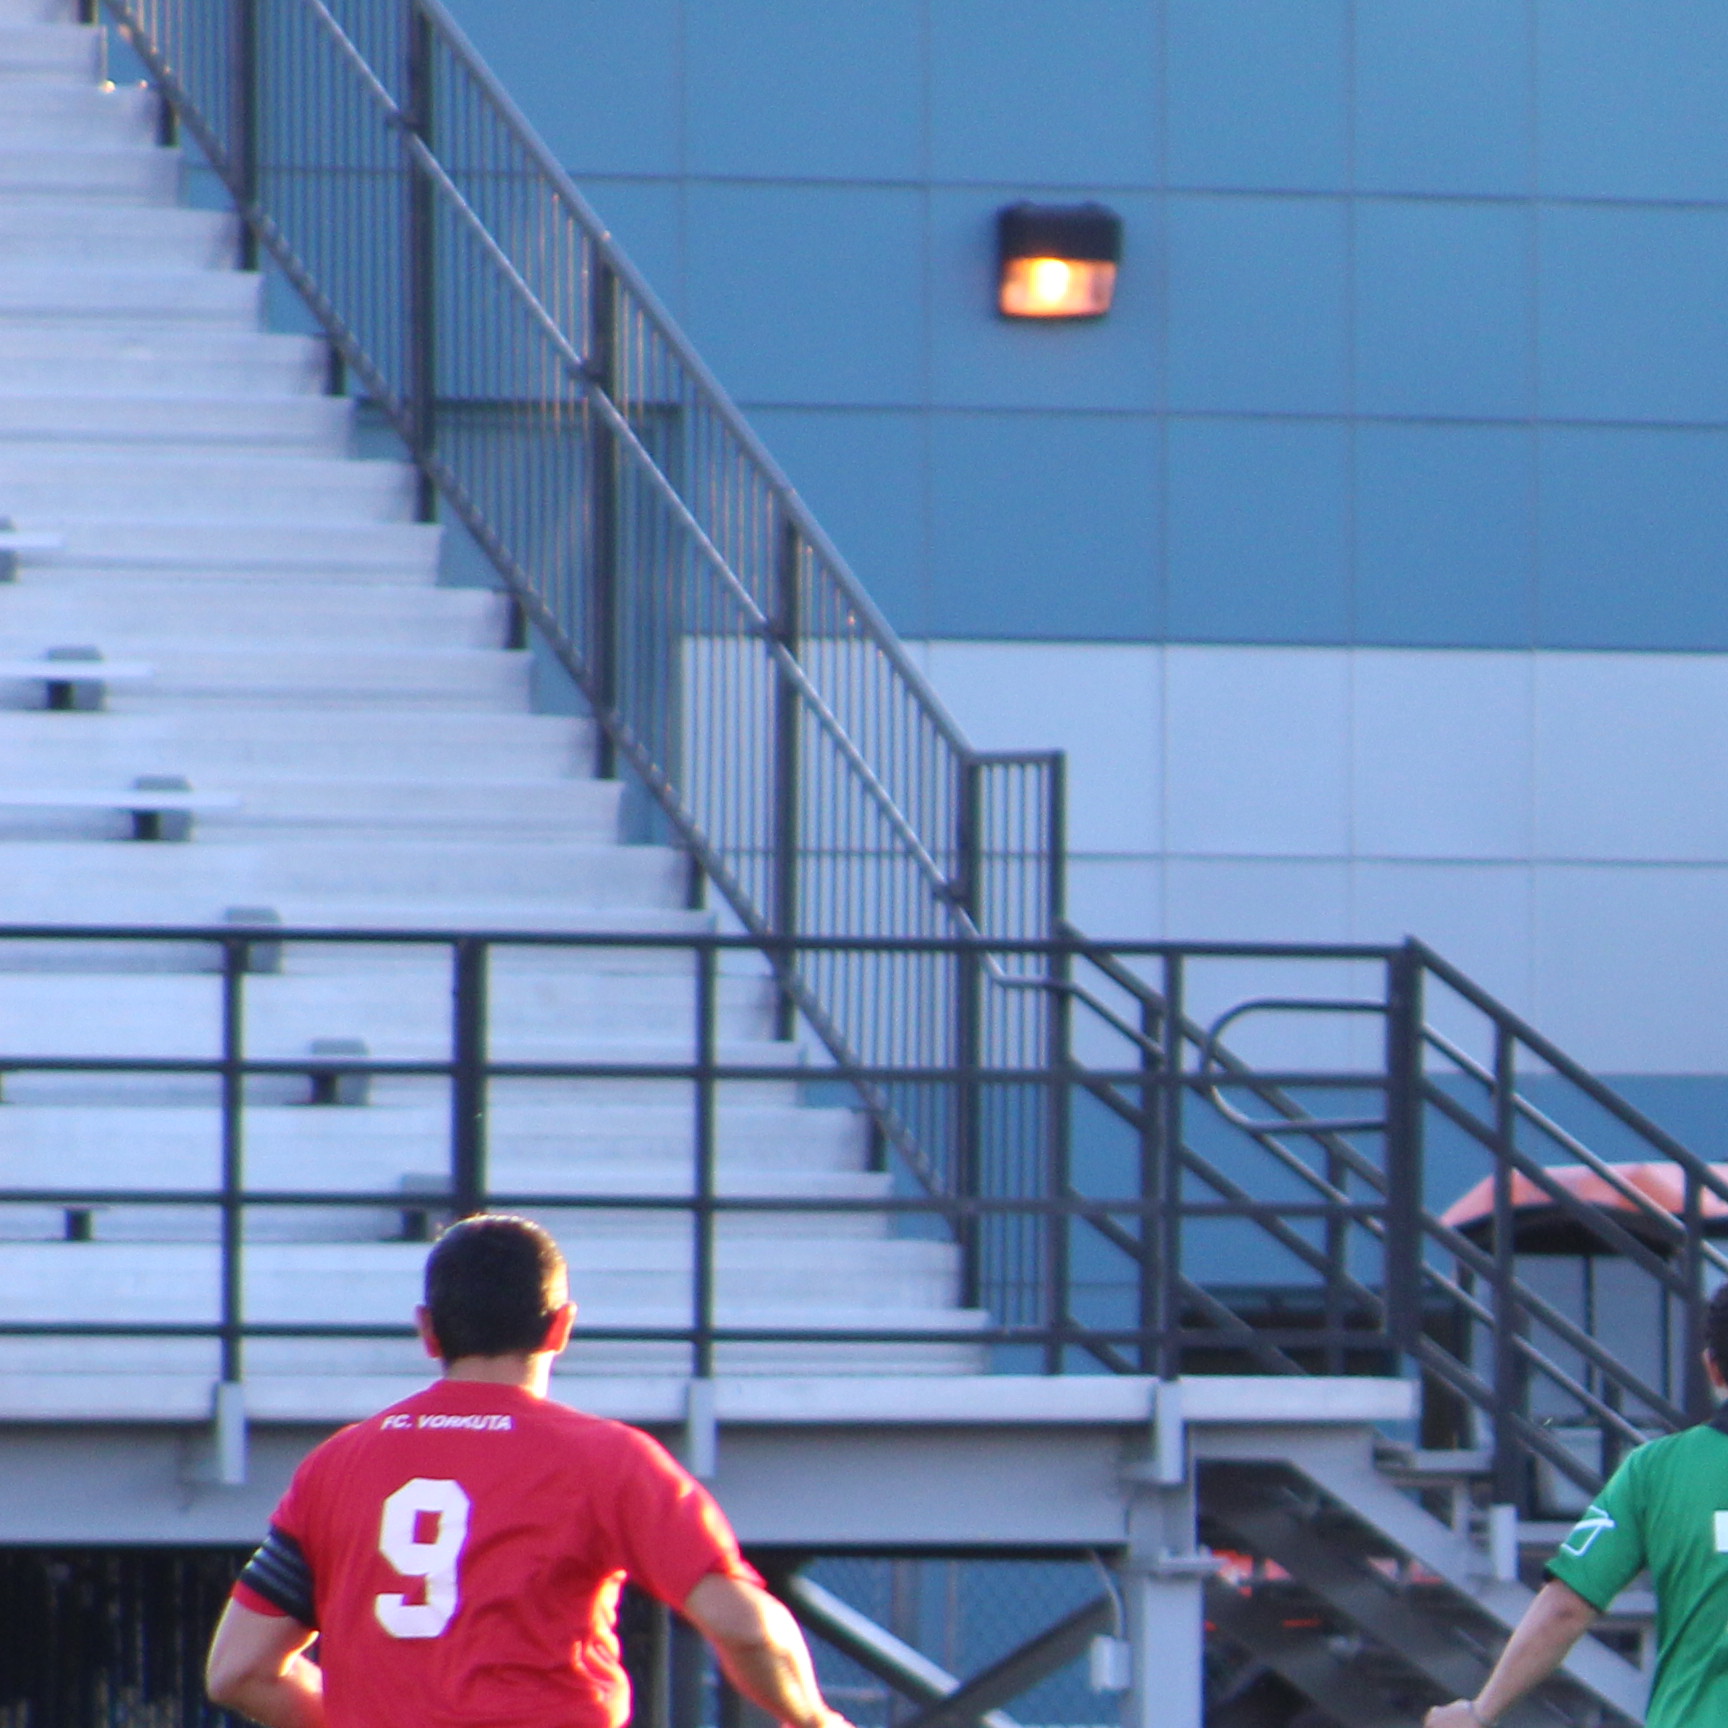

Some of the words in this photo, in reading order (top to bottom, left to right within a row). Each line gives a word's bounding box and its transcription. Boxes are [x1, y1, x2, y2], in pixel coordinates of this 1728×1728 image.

[381, 1413, 413, 1431] FC.
[418, 1413, 512, 1431] VORKUTA
[374, 1477, 471, 1639] 9
